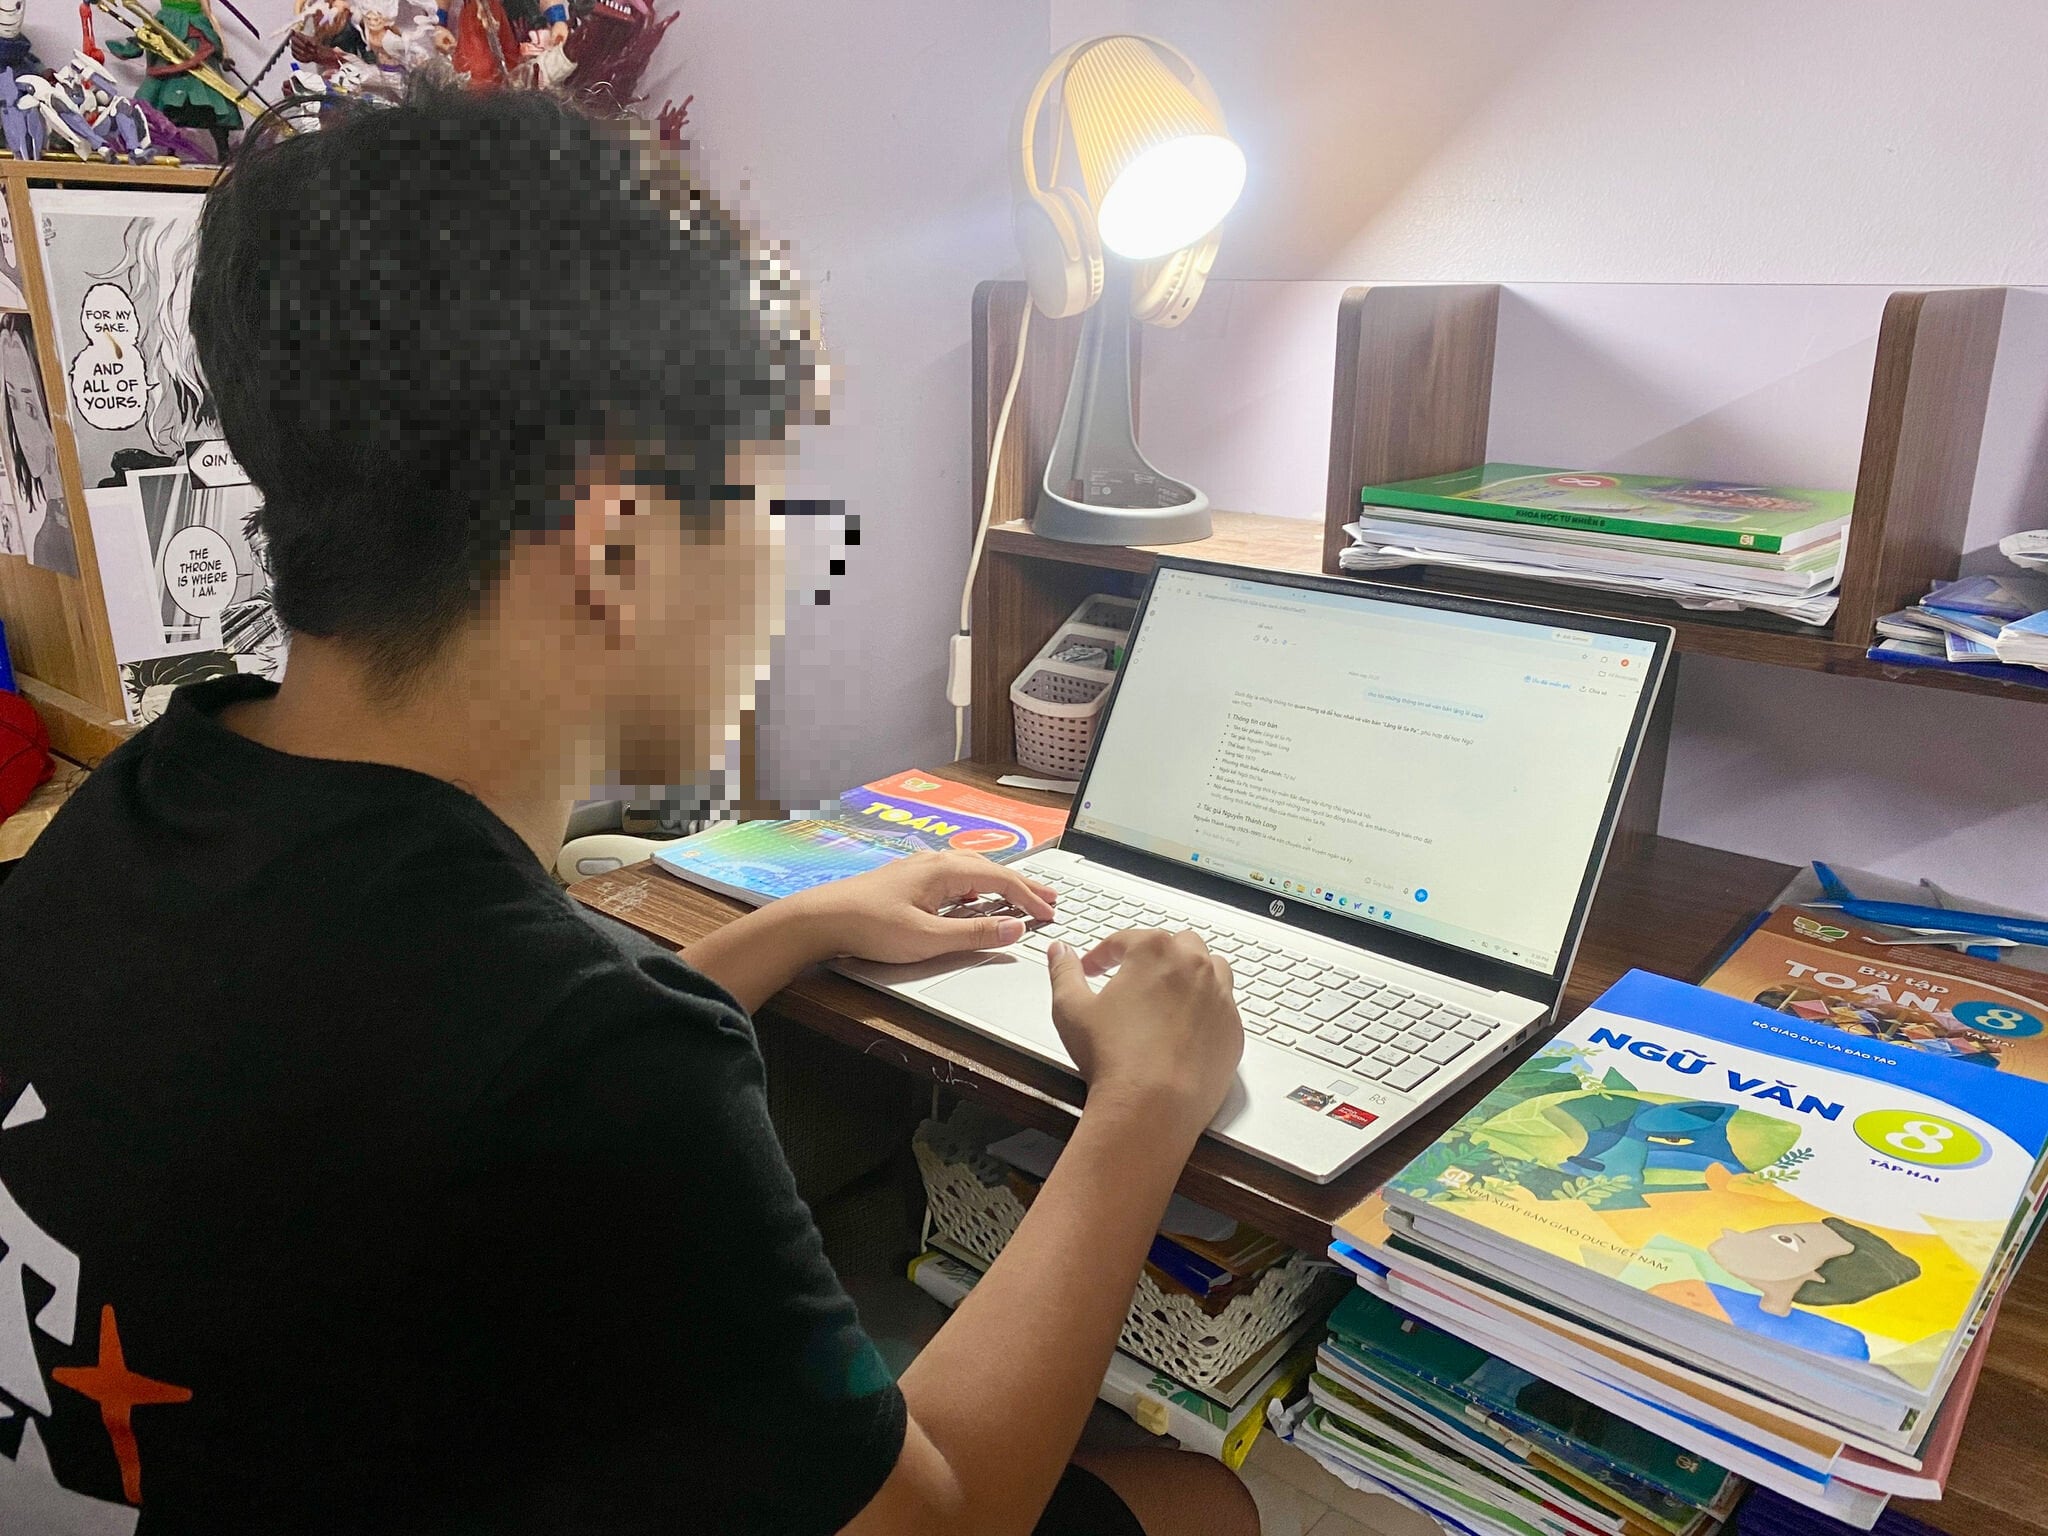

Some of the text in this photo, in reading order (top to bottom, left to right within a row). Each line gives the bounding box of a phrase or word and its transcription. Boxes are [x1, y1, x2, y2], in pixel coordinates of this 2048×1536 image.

[85, 309, 131, 321] FOR MY
[94, 322, 129, 333] SAKE.
[93, 363, 124, 376] AND
[83, 379, 139, 393] ALL OF
[84, 396, 141, 410] YOURS.
[1516, 509, 1539, 519] KHOA
[189, 548, 209, 560] THE
[180, 560, 222, 574] THRONE
[178, 572, 228, 587] IS WHERE
[192, 585, 217, 598] I AM.
[860, 802, 962, 837] TOÁN
[962, 831, 1012, 846] 7
[1785, 959, 1940, 1013] TOÁN
[1857, 965, 1949, 994] Bài tập
[1974, 1008, 2024, 1030] 8
[1770, 1025, 1799, 1039] GIÁO
[1800, 1035, 1825, 1048] DỤC
[1587, 1027, 1846, 1122] NGỮ VĂN
[1885, 1120, 1954, 1154] 8
[1869, 1158, 1940, 1184] TẬP HAI
[1524, 1208, 1548, 1225] BẢN
[1549, 1219, 1580, 1237] GIÁO
[1637, 1254, 1669, 1272] NAM
